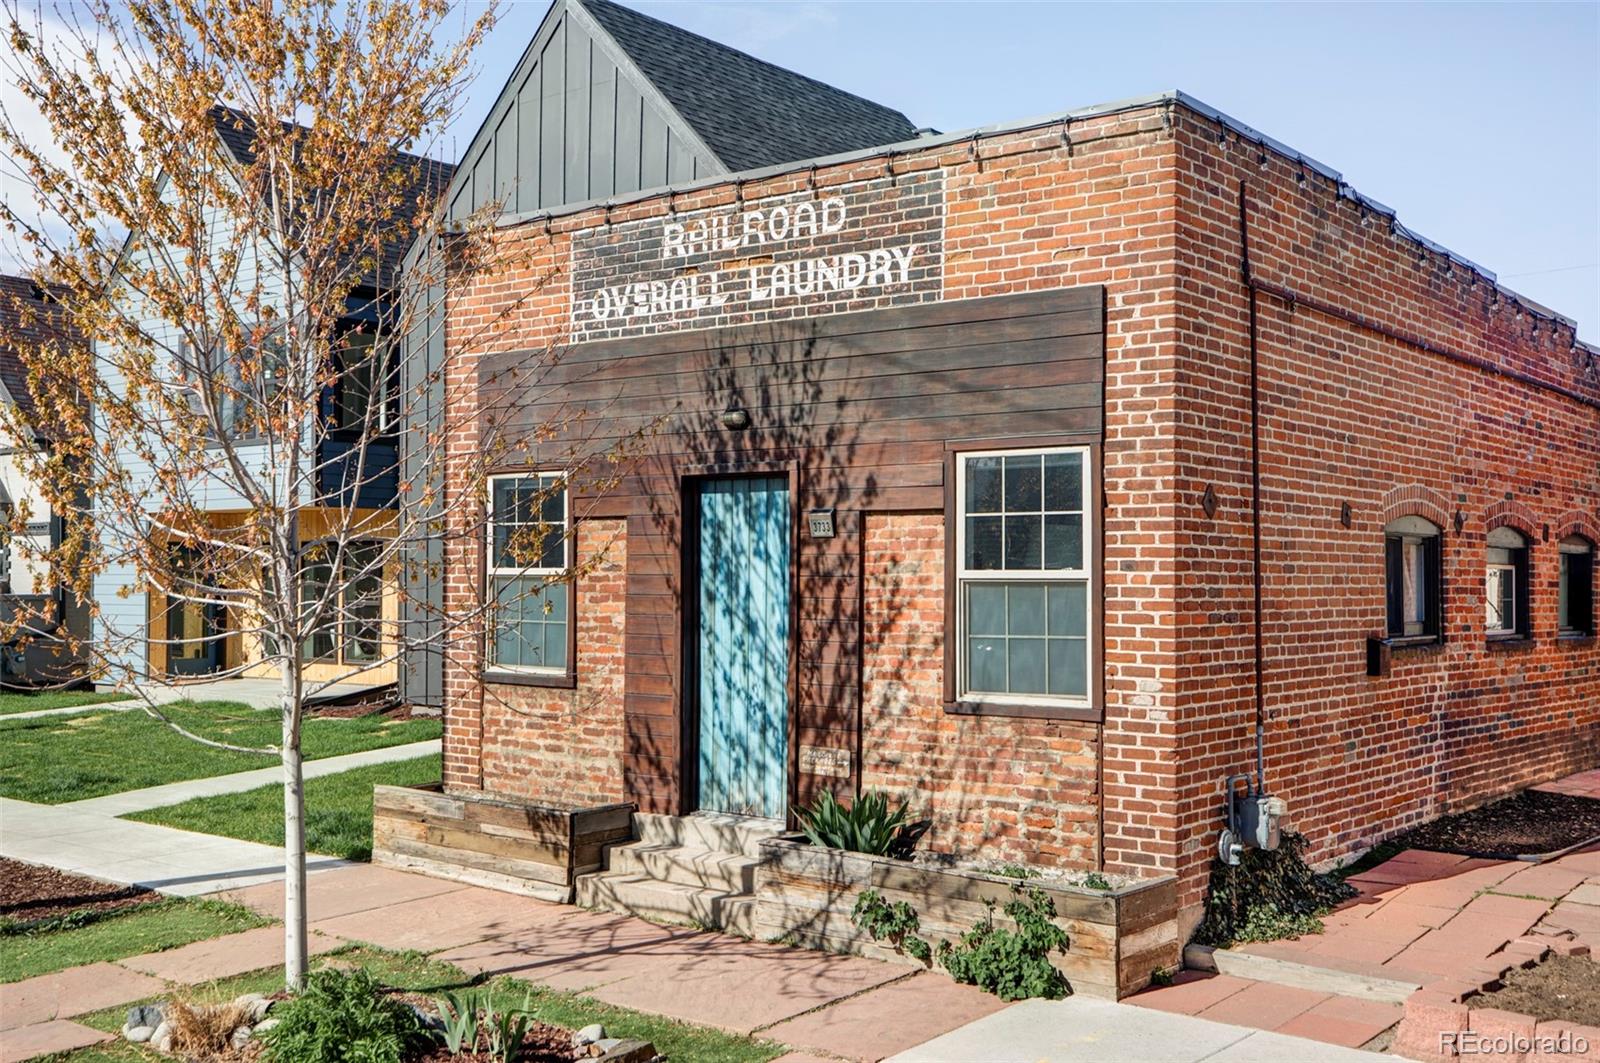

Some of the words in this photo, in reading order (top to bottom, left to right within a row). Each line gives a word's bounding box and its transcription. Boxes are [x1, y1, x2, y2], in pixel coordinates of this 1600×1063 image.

[663, 198, 847, 258] RAILROAD
[591, 272, 729, 321] OVERALL
[749, 246, 916, 301] LAUNDRY
